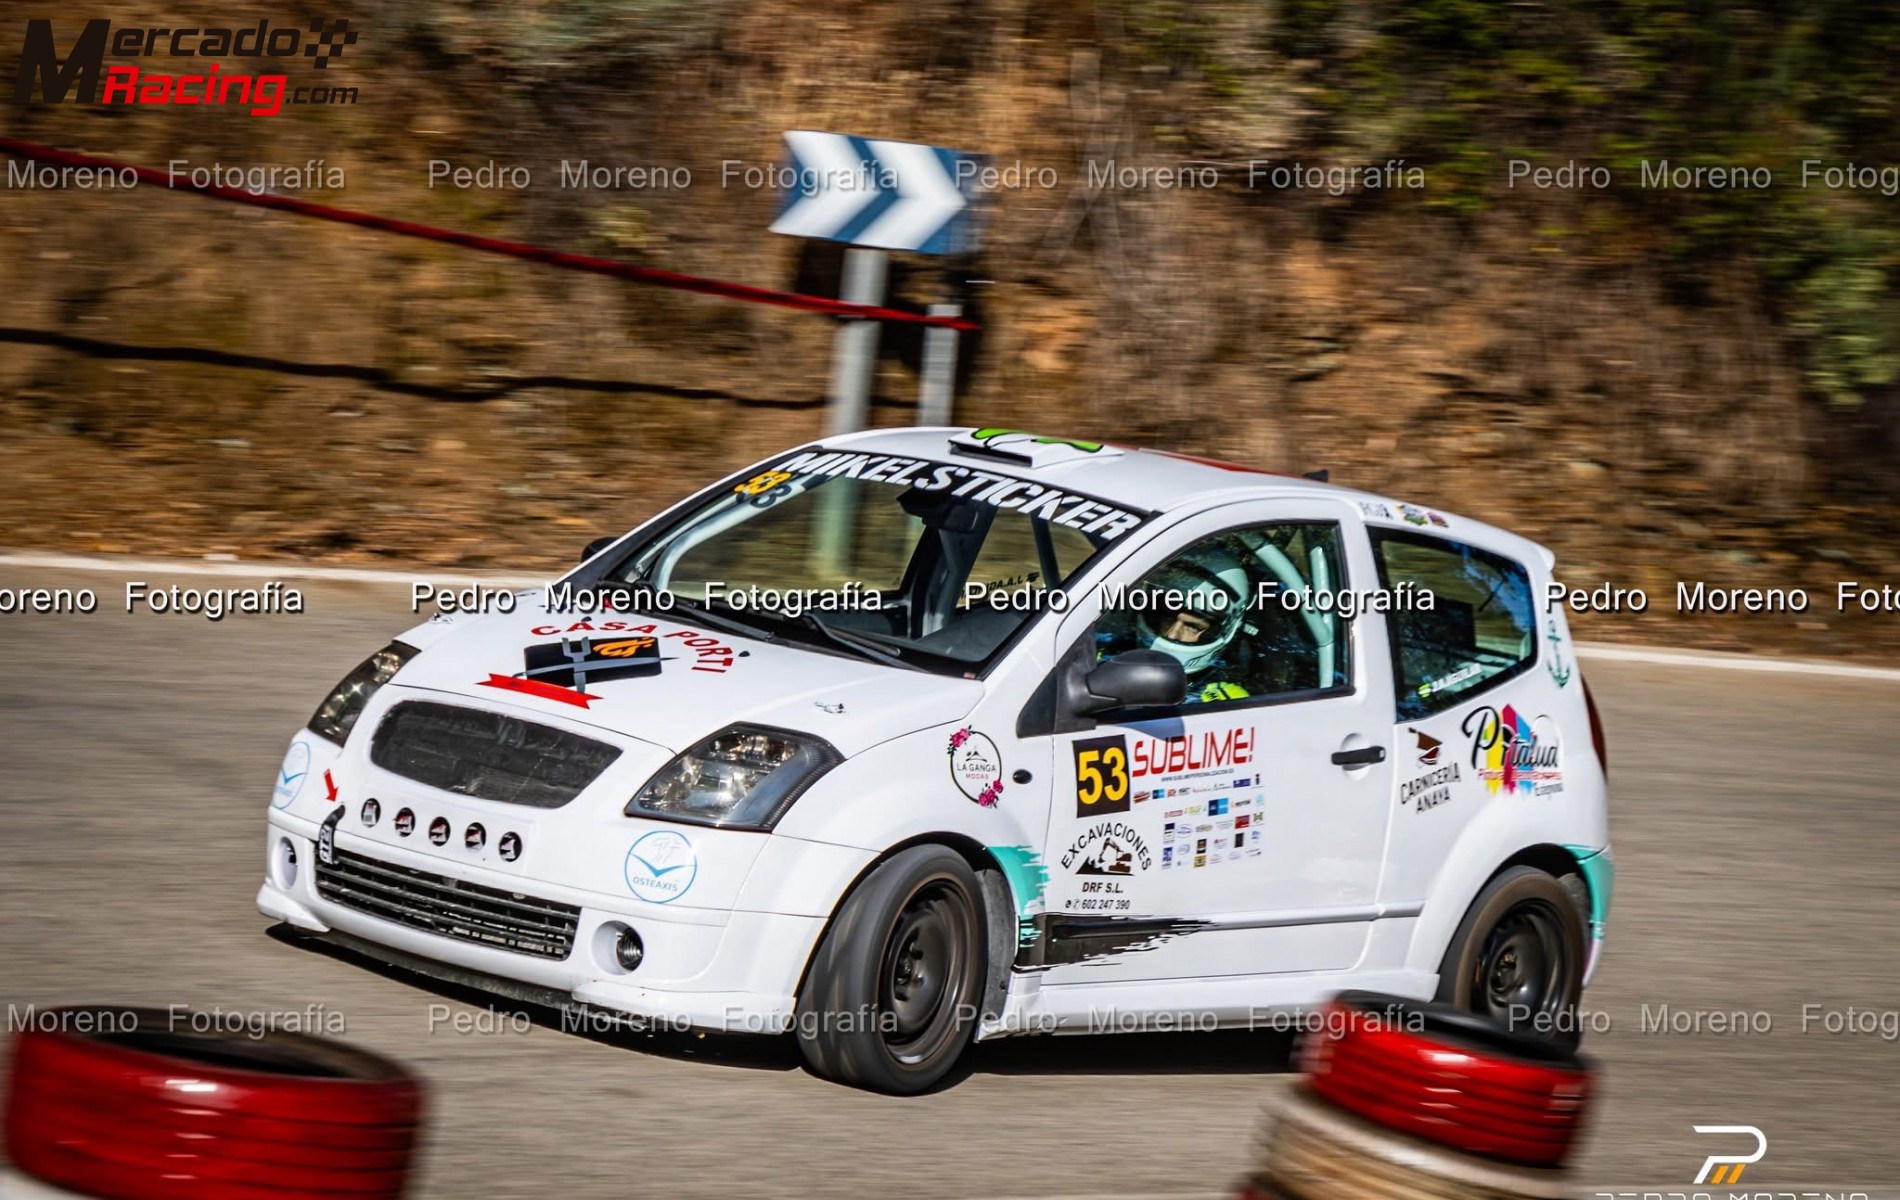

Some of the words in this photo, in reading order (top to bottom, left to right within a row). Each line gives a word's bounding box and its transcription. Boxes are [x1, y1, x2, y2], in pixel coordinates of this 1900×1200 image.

[771, 450, 1145, 541] MIKELSTICKER
[531, 621, 658, 636] CASA
[663, 630, 734, 674] PORTI
[956, 763, 968, 771] LA
[969, 763, 997, 773] GANGA
[1132, 727, 1255, 777] SUBLIME!
[1077, 746, 1129, 805] 53
[1416, 786, 1451, 813] ANAYA
[1061, 822, 1153, 871] EXCAVACIONES
[632, 876, 678, 892] OSTEAXIS
[1082, 882, 1103, 893] DRF
[1105, 883, 1124, 894] S.L.
[1081, 899, 1097, 910] 602
[1098, 899, 1114, 910] 247
[1115, 899, 1131, 910] 390
